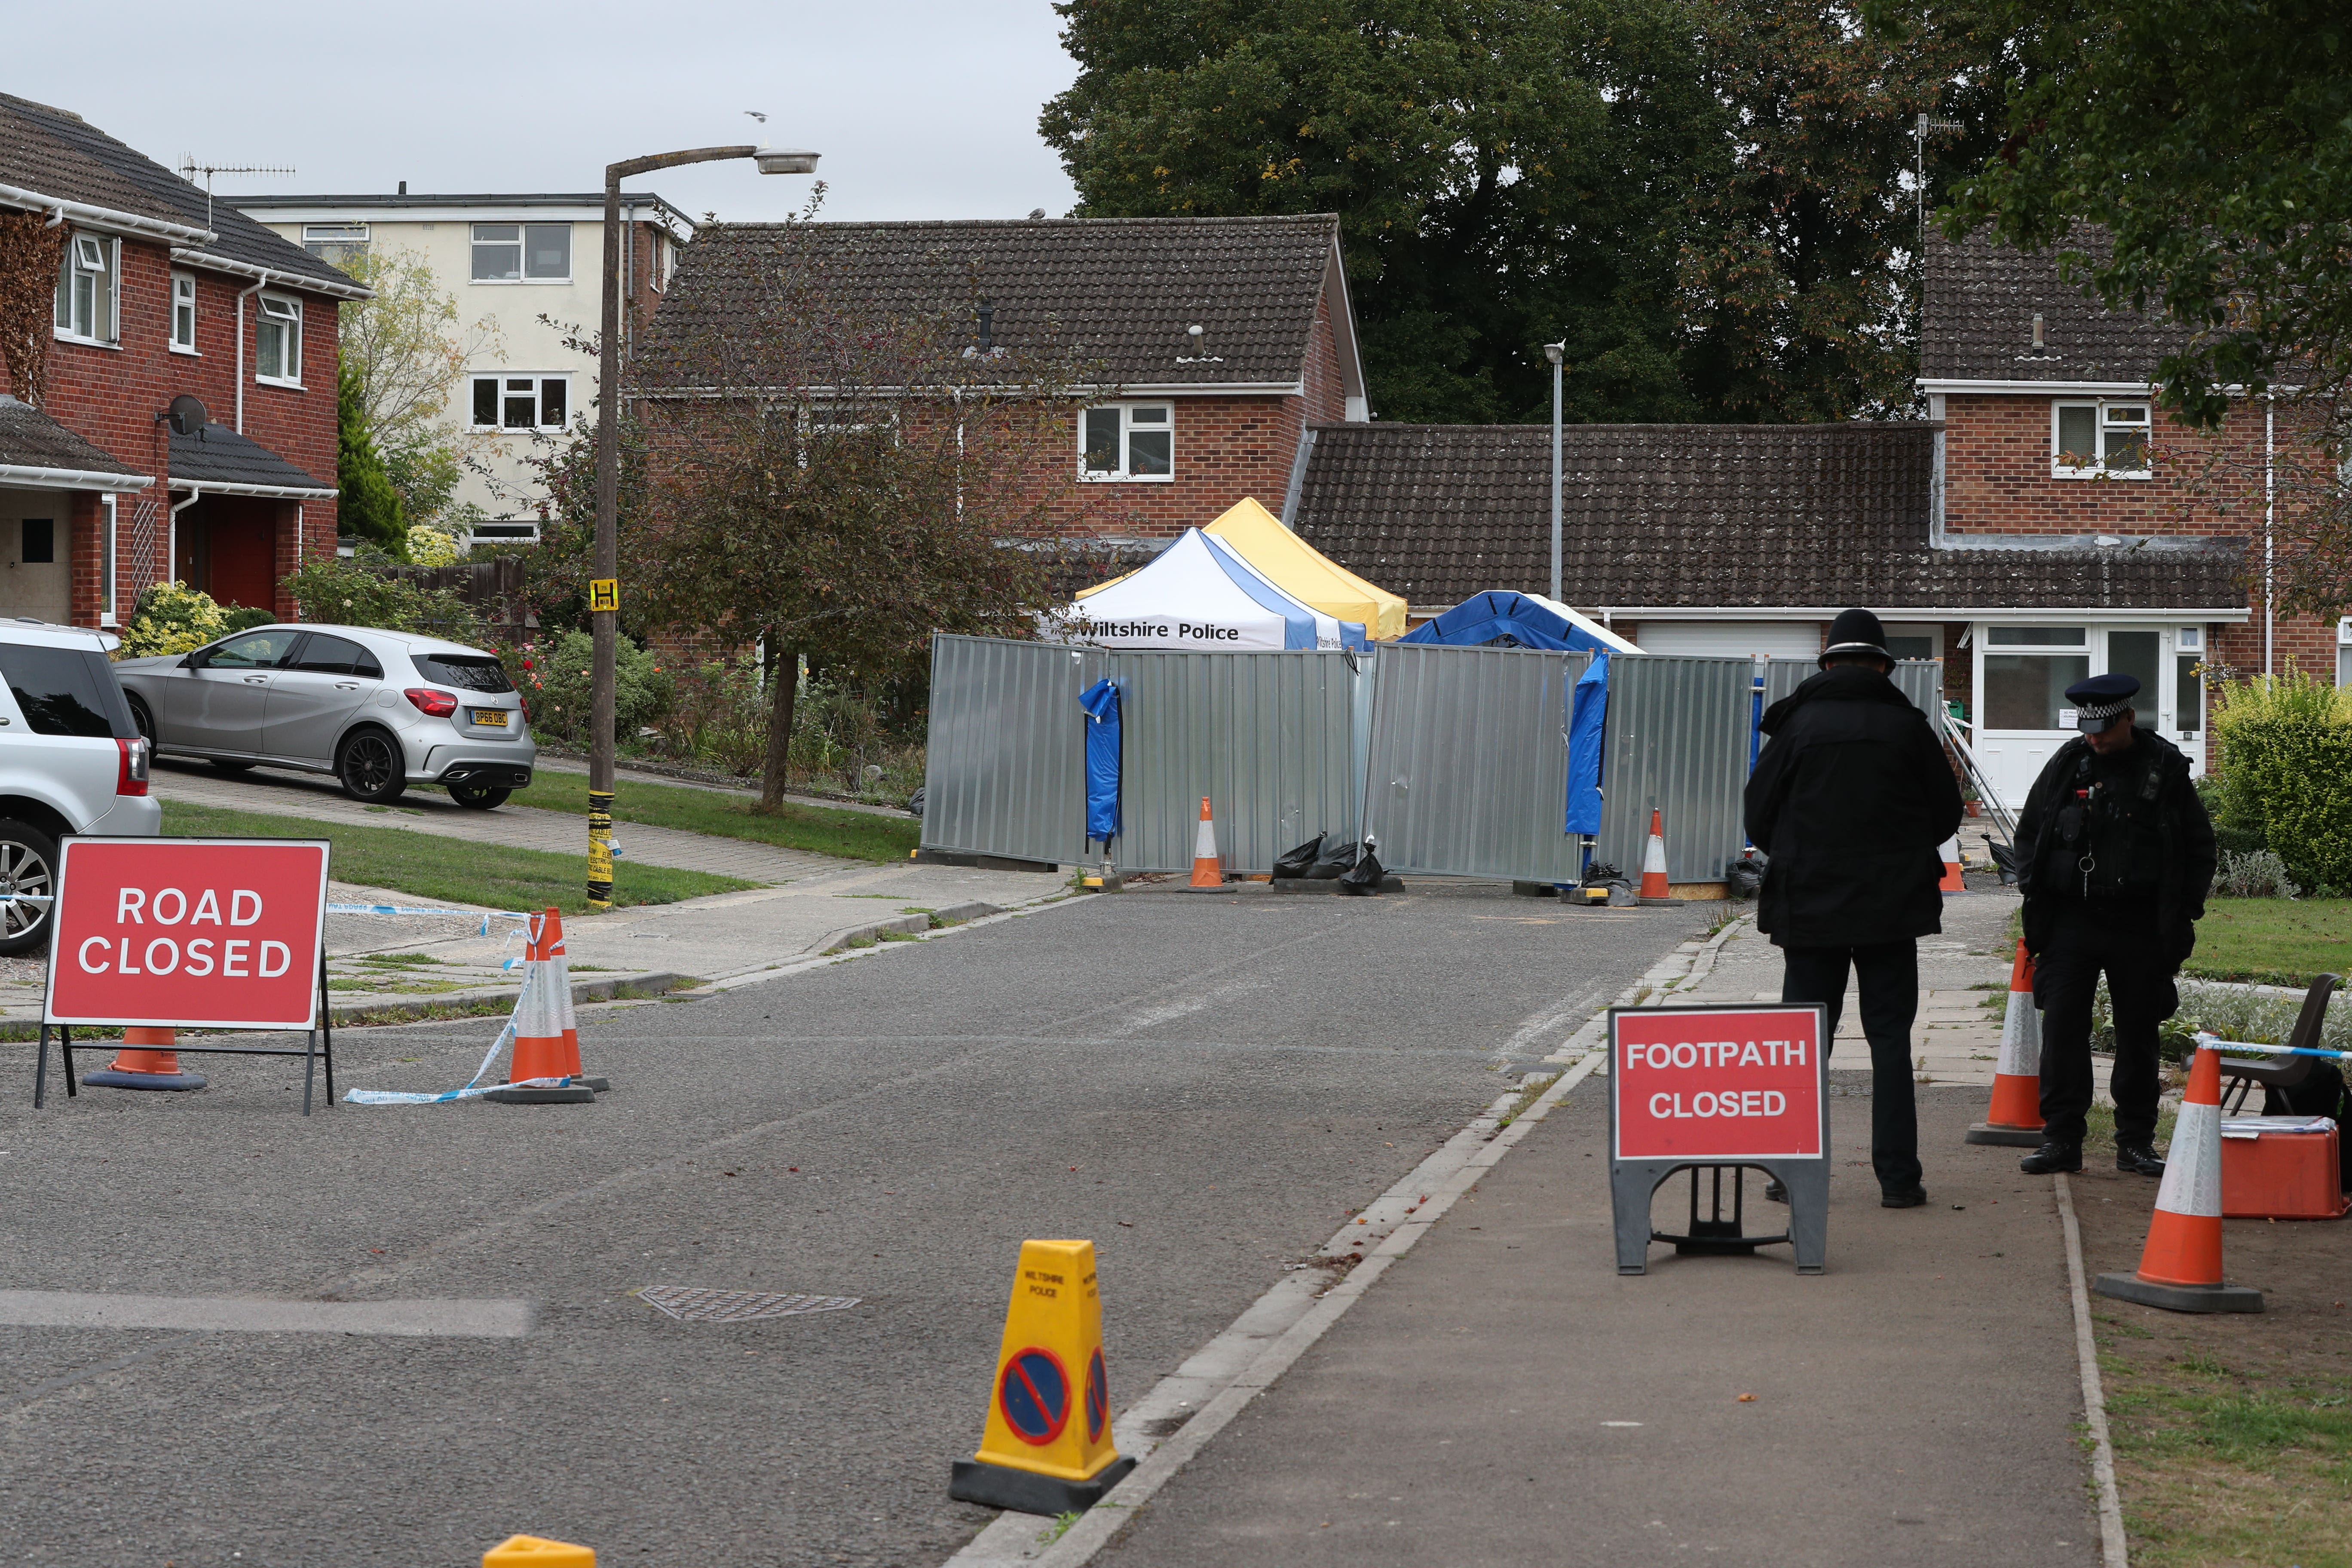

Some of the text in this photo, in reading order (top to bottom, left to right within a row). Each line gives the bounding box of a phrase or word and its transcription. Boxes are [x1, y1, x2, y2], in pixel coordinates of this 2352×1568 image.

[594, 582, 614, 607] H
[1079, 622, 1238, 640] Wiltshire Police
[1332, 637, 1341, 649] Police
[476, 712, 493, 722] BP66
[116, 887, 263, 926] ROAD
[77, 936, 291, 978] CLOSED
[1627, 1040, 1806, 1069] FOOTPATH
[1648, 1090, 1787, 1119] CLOSED
[1025, 1271, 1064, 1285] WILTSHIRE
[1029, 1285, 1057, 1298] POLICE
